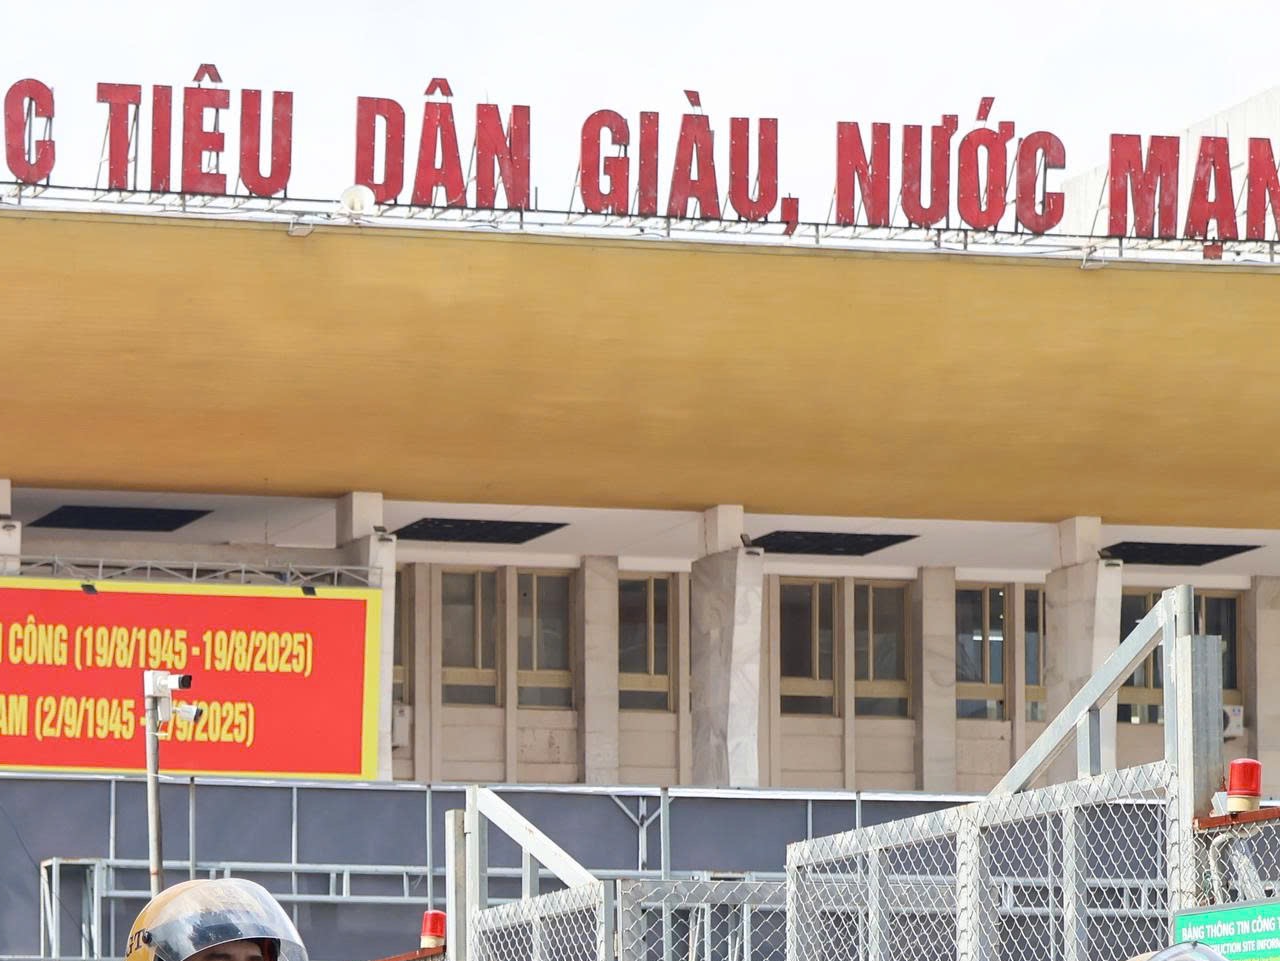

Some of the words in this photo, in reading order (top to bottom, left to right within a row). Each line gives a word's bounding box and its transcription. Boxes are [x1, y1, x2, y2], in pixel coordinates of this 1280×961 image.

[97, 63, 293, 197] TIÊU
[355, 77, 531, 210] DÂN
[580, 90, 799, 237] GIÀU,
[836, 97, 1066, 235] NƯỚC
[8, 614, 68, 666] CÔNG
[1236, 919, 1250, 932] TIN
